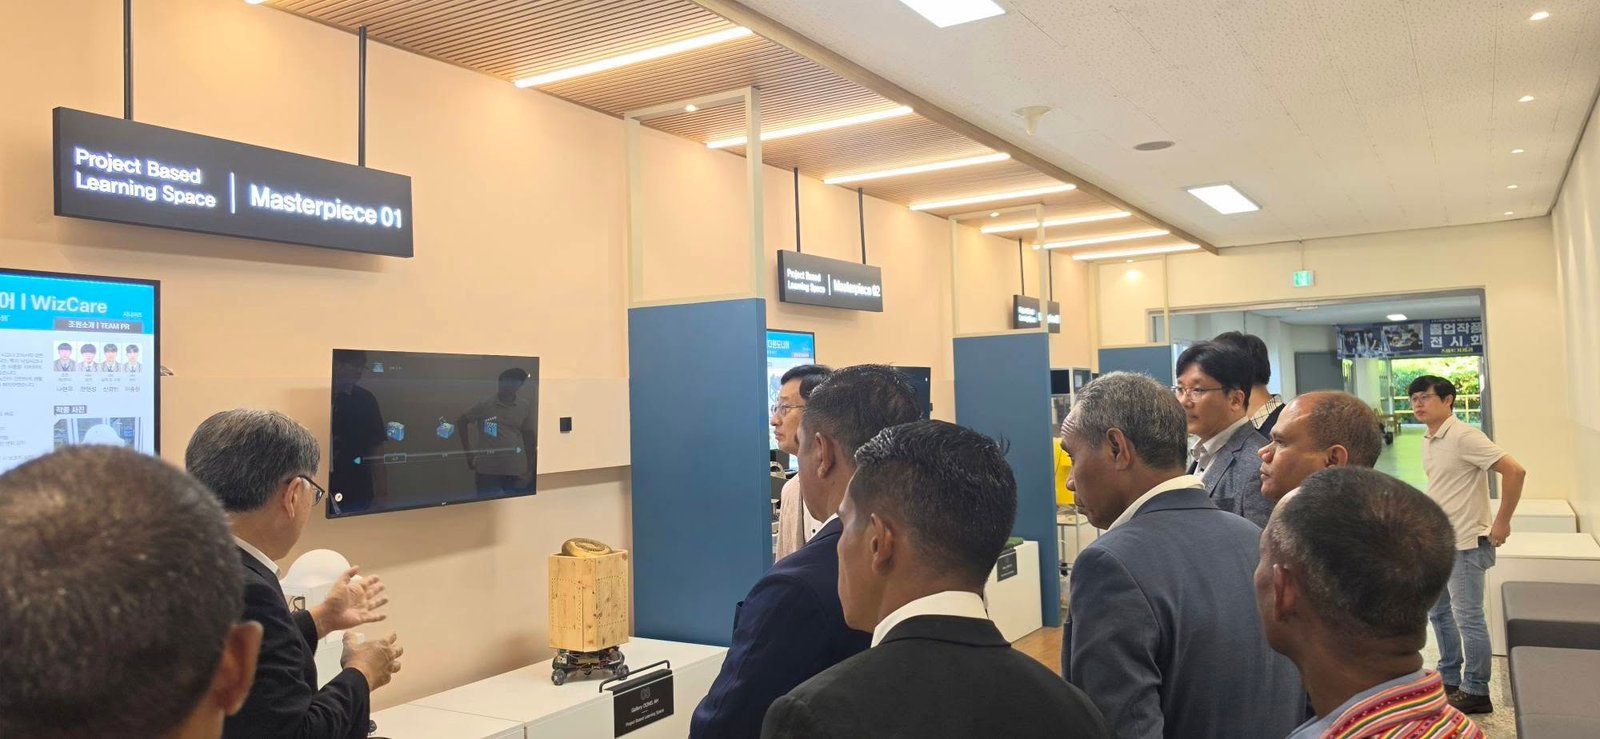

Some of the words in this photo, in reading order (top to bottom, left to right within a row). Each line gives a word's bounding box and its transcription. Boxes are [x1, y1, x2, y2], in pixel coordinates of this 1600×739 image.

[75, 147, 141, 174] Project
[147, 160, 202, 184] Based
[75, 170, 157, 201] Learning
[162, 185, 216, 208] Space
[250, 184, 377, 224] Masterpiece
[380, 206, 402, 229] 01
[833, 279, 872, 296] Masterpiece
[31, 294, 108, 314] WizCare
[101, 322, 119, 330] TEAM
